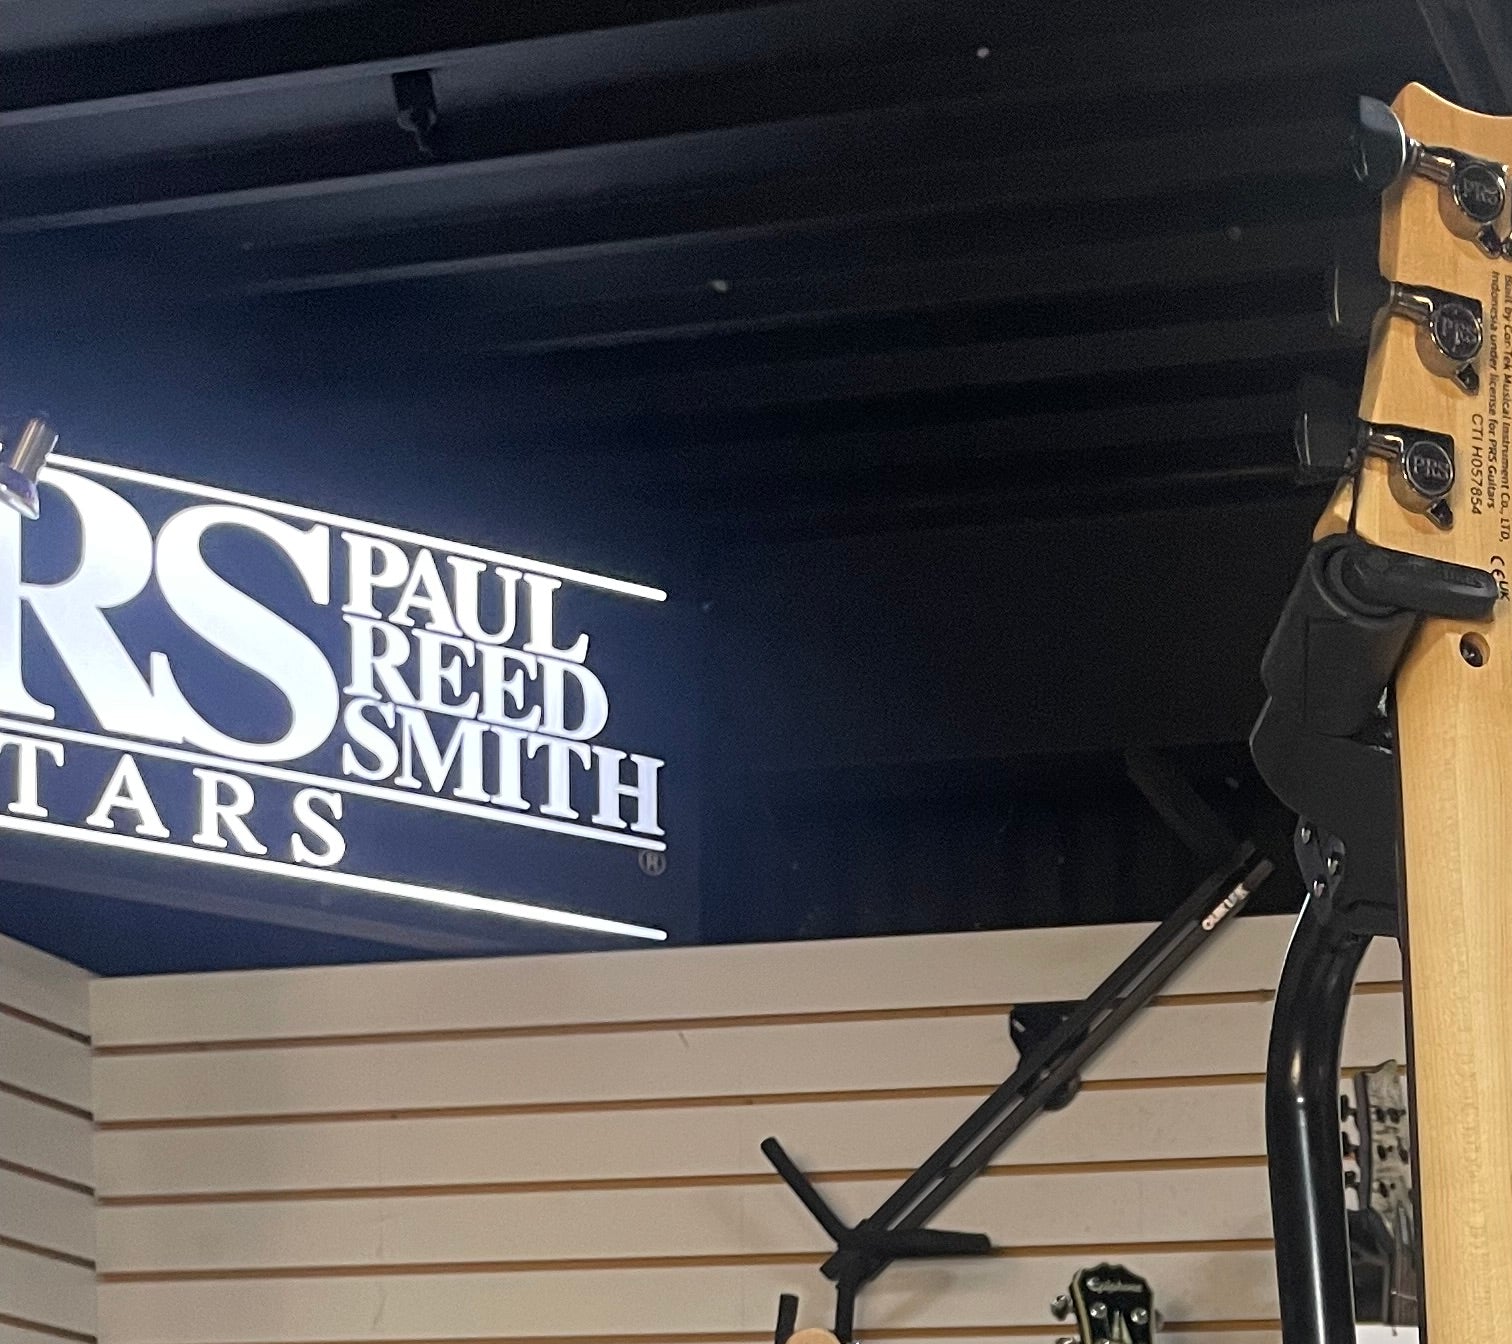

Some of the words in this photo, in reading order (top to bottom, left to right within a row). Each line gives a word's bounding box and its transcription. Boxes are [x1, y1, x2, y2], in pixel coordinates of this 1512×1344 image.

[1462, 178, 1498, 205] PRS
[1490, 271, 1501, 330] Indonesia
[1489, 334, 1499, 371] under
[1488, 374, 1499, 416] license
[1502, 373, 1512, 419] Musical
[1488, 419, 1498, 435] for
[1413, 455, 1450, 480] PRS
[1487, 439, 1497, 462] PRS
[1500, 422, 1511, 489] Instrument
[1470, 446, 1483, 515] H057854
[1487, 465, 1497, 509] Guitars
[341, 531, 590, 663] PAUL
[343, 614, 610, 743] REED
[342, 700, 666, 837] SMITH
